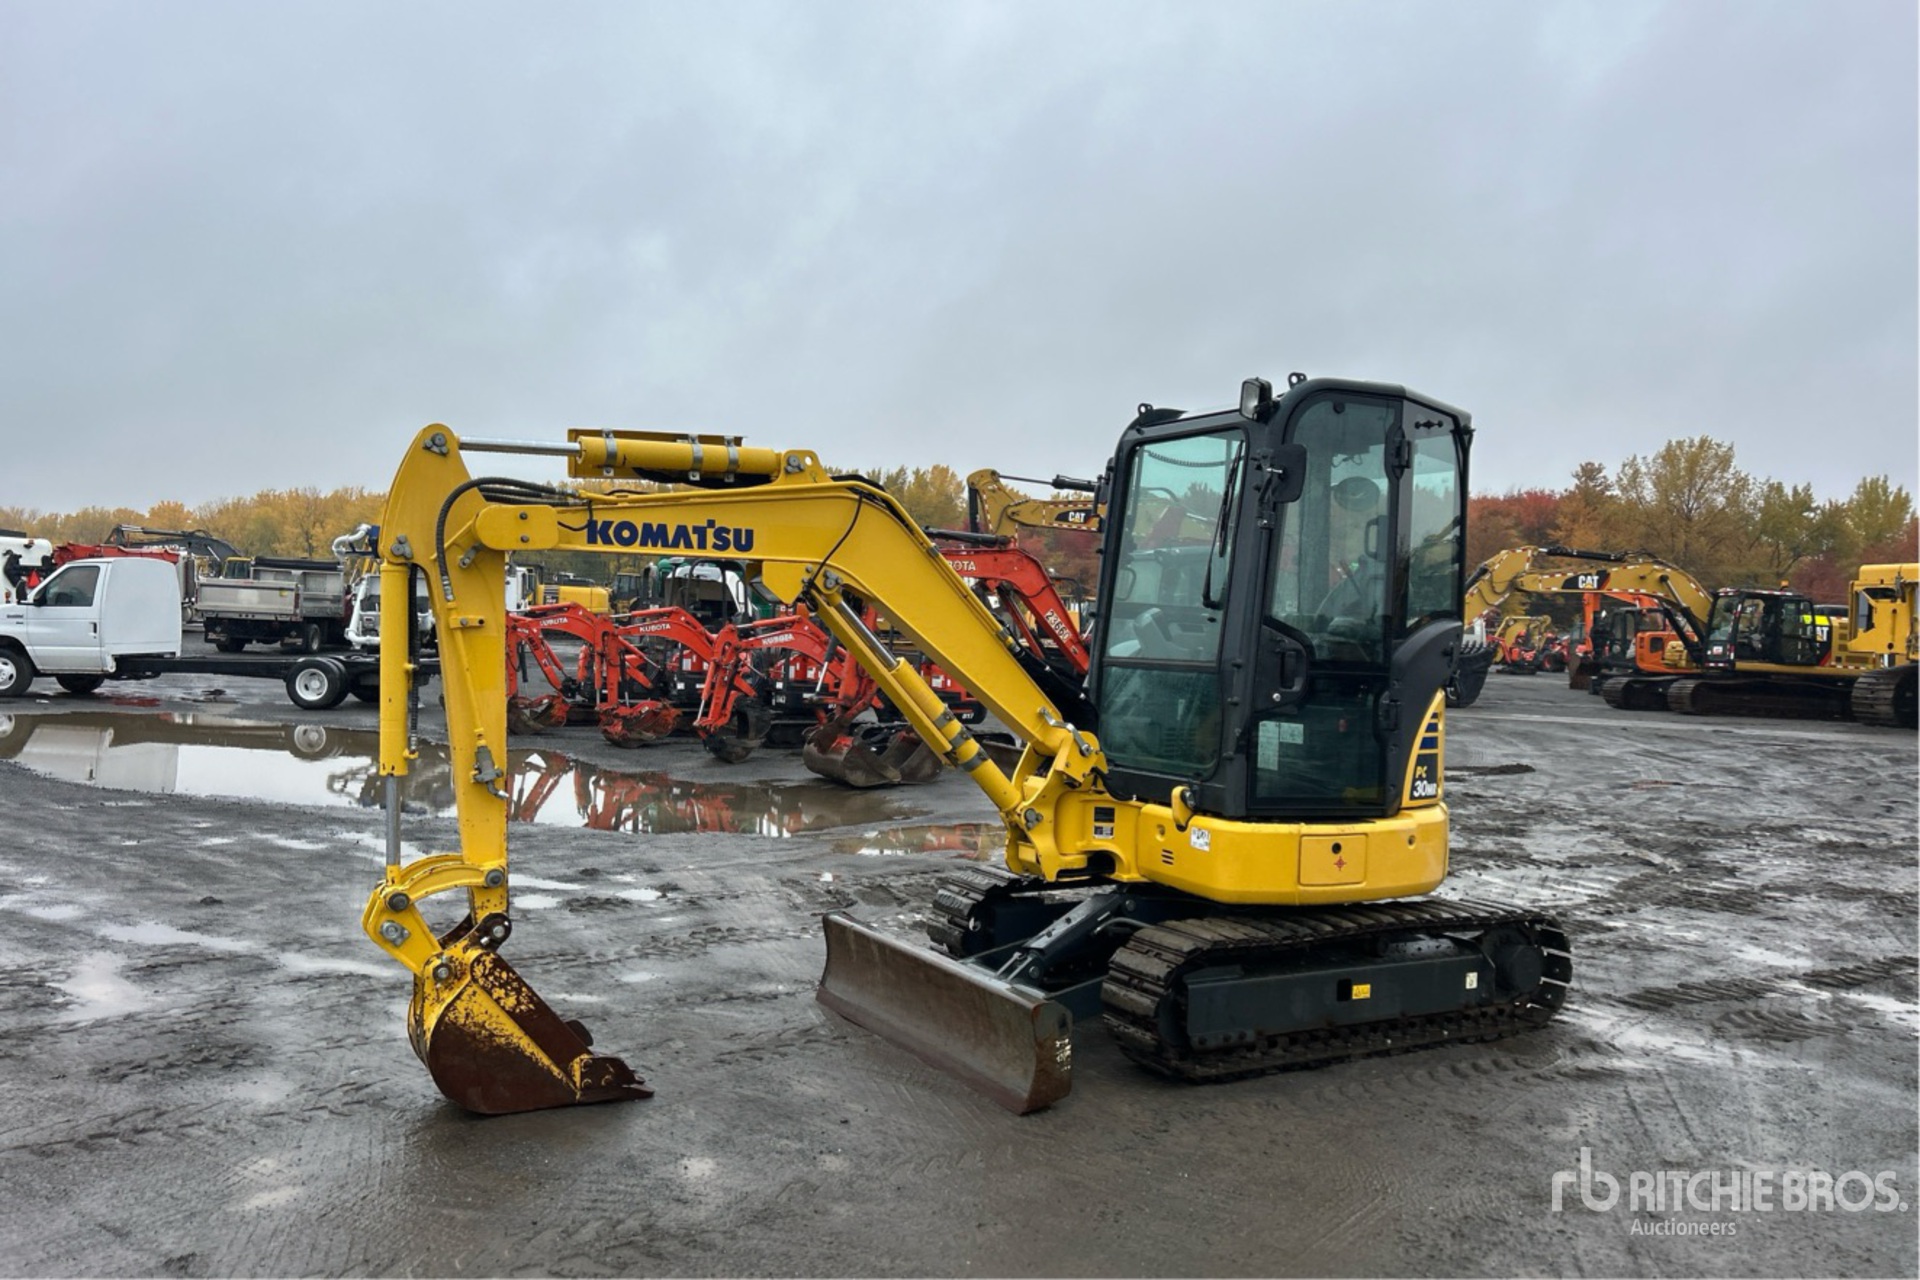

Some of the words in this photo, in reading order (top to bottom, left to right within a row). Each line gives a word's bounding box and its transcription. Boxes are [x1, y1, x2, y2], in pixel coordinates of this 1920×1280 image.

[1068, 511, 1086, 523] CAT
[587, 519, 754, 552] KOMATSU
[1578, 575, 1599, 589] CAT
[640, 623, 671, 632] KUBOTA
[1415, 766, 1428, 778] PC
